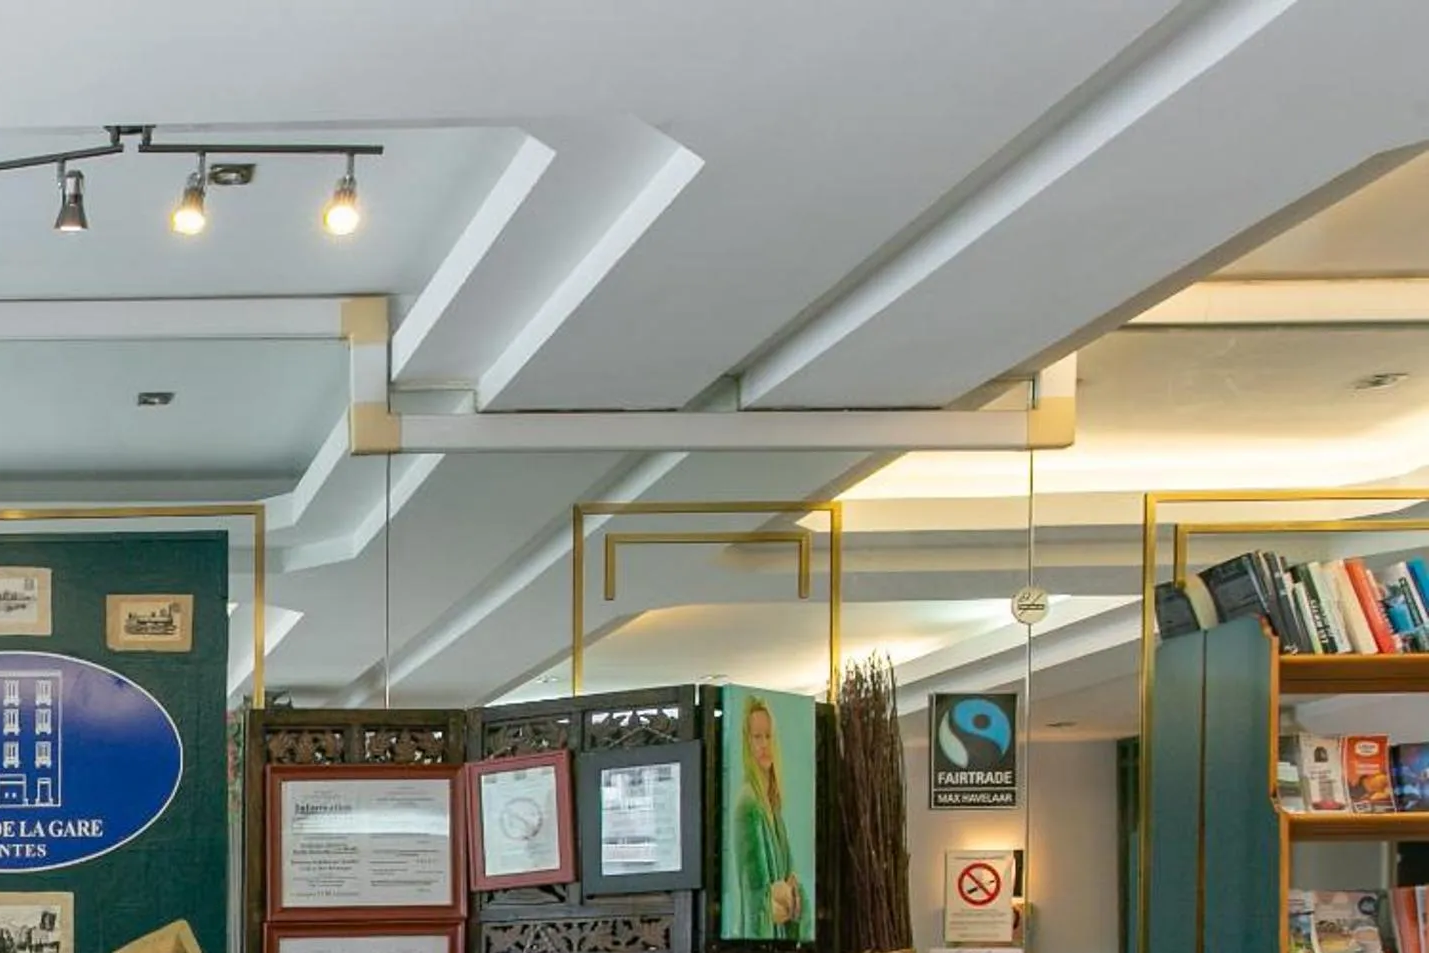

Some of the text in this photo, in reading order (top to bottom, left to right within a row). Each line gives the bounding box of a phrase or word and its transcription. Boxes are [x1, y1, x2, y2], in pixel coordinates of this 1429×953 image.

[937, 771, 1013, 785] FAIRTRADE
[937, 792, 1013, 803] MAX HAVELAAR
[19, 820, 46, 838] LA
[48, 819, 104, 838] GARE
